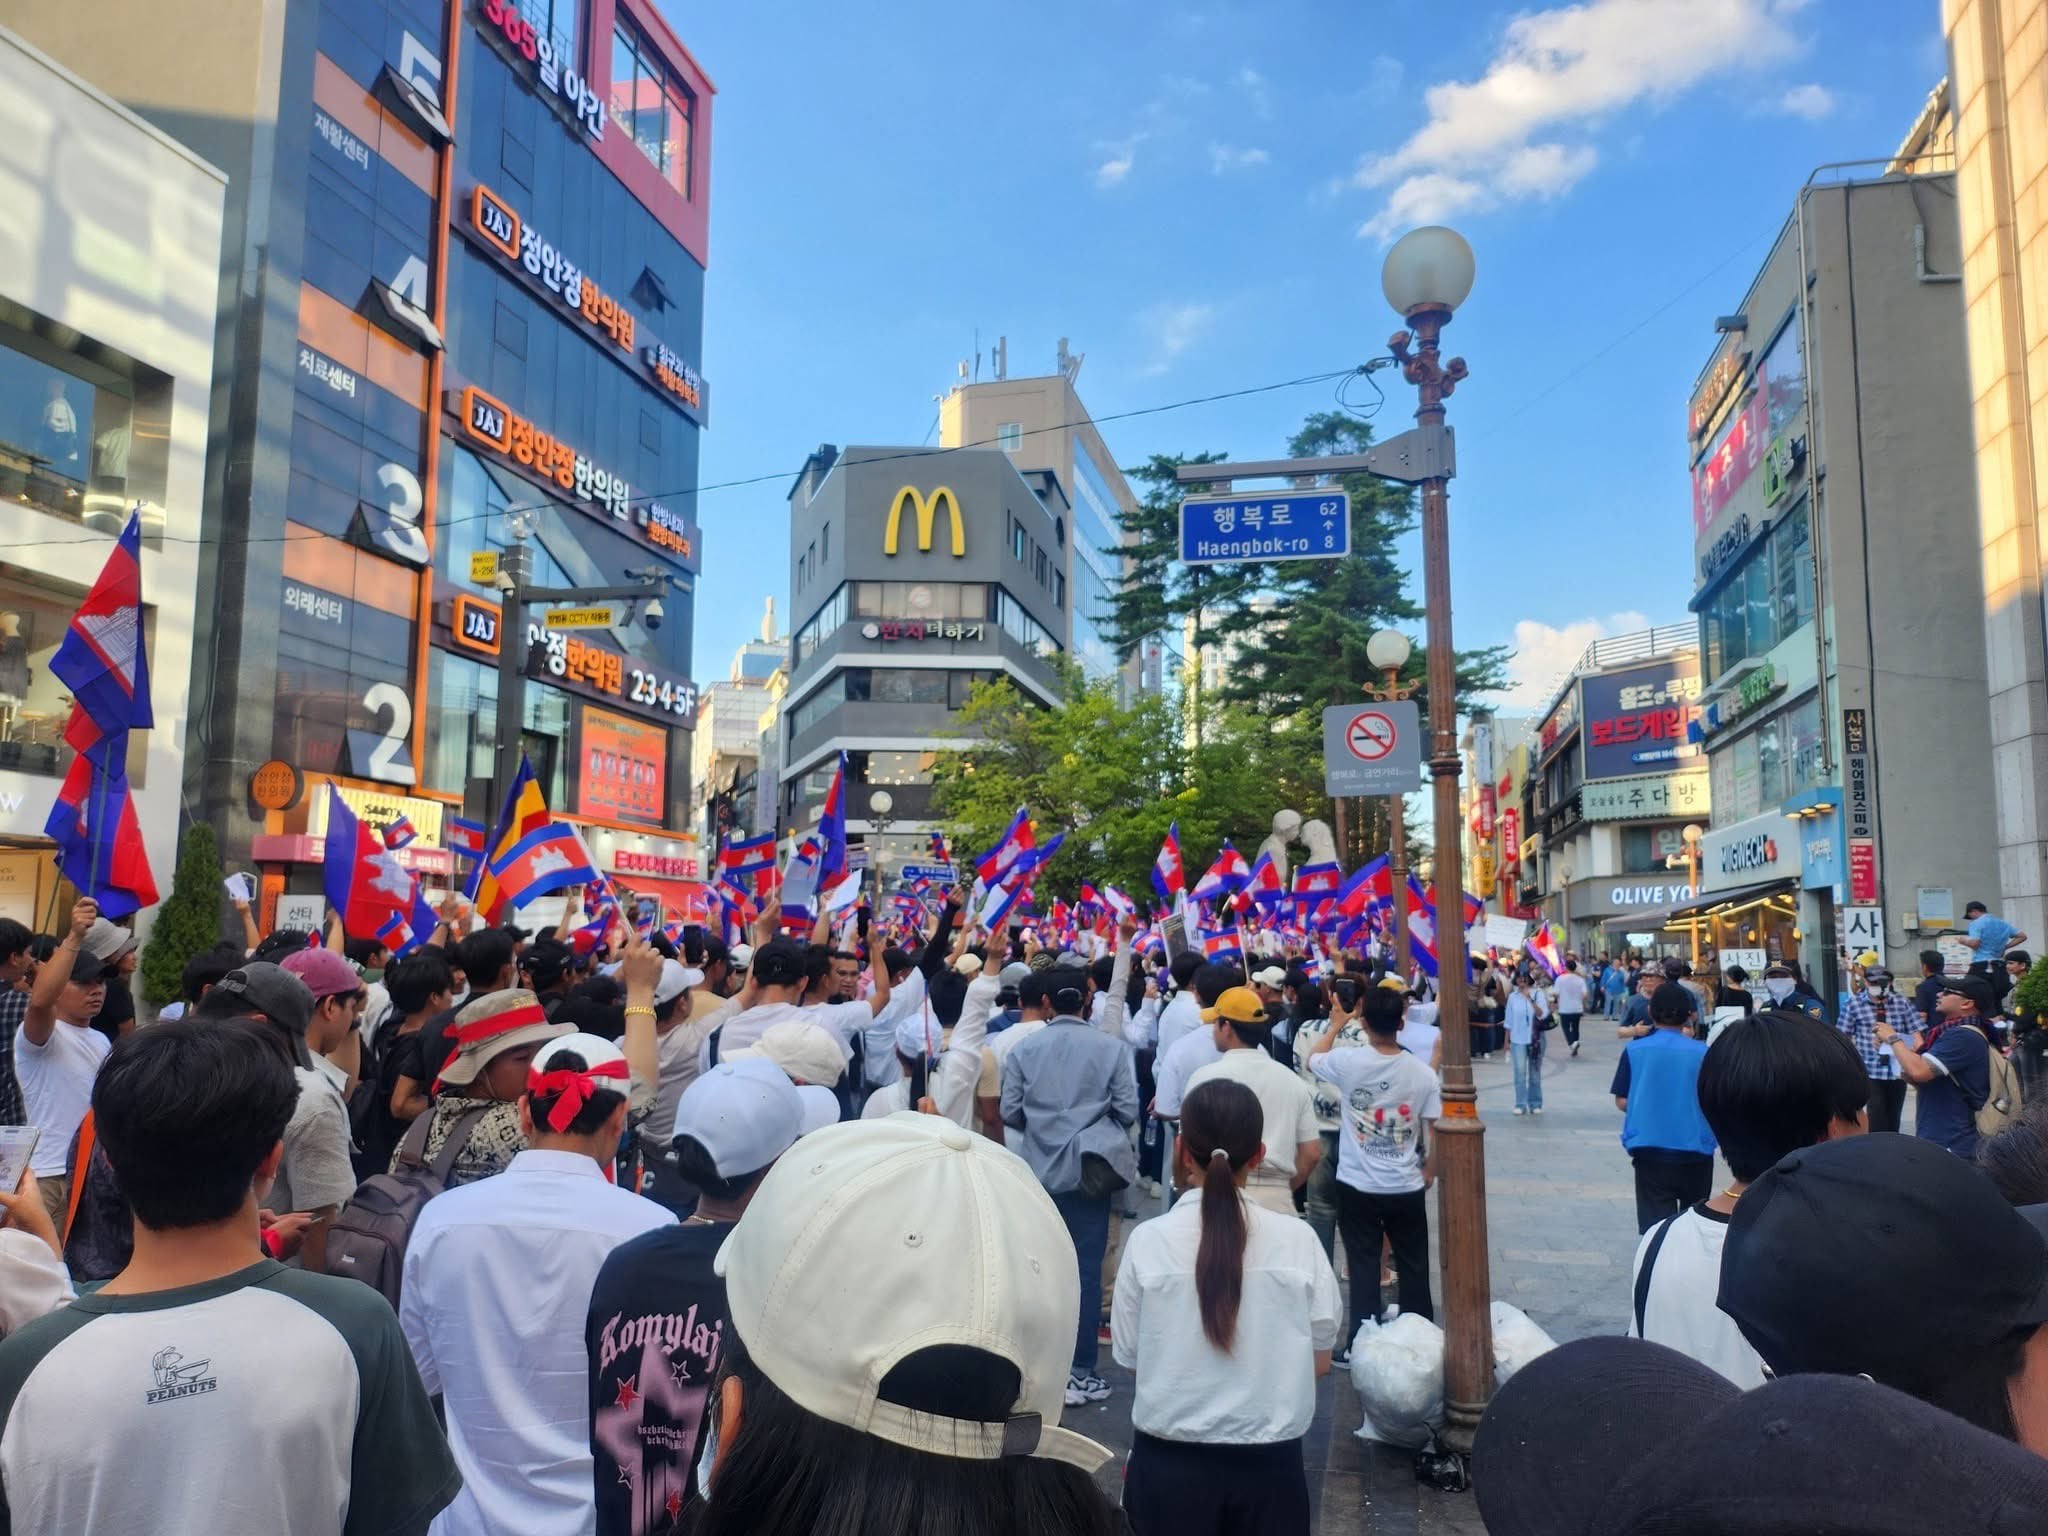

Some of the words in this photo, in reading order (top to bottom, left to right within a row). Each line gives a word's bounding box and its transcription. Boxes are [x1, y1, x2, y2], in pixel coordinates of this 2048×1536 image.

[564, 69, 607, 142] 야간
[314, 112, 369, 170] 재활센터
[484, 206, 513, 241] JAJ
[520, 222, 635, 353] 정안정한의원
[388, 254, 442, 348] 4
[299, 349, 356, 398] 치료센터
[475, 405, 504, 437] JAJ
[511, 414, 629, 521] 정안정한의원
[377, 463, 430, 564] 3
[1213, 504, 1292, 533] 행복로
[1319, 502, 1338, 516] 62
[1198, 537, 1309, 557] Haengbok-ro
[1323, 535, 1334, 549] 8
[284, 586, 343, 625] 외래센터
[569, 613, 590, 623] CCTV
[466, 612, 495, 641] JAJ
[363, 682, 416, 785] 2
[1612, 886, 1664, 904] OLIVE
[289, 906, 313, 920] 산타
[146, 1379, 217, 1403] PEANUTS
